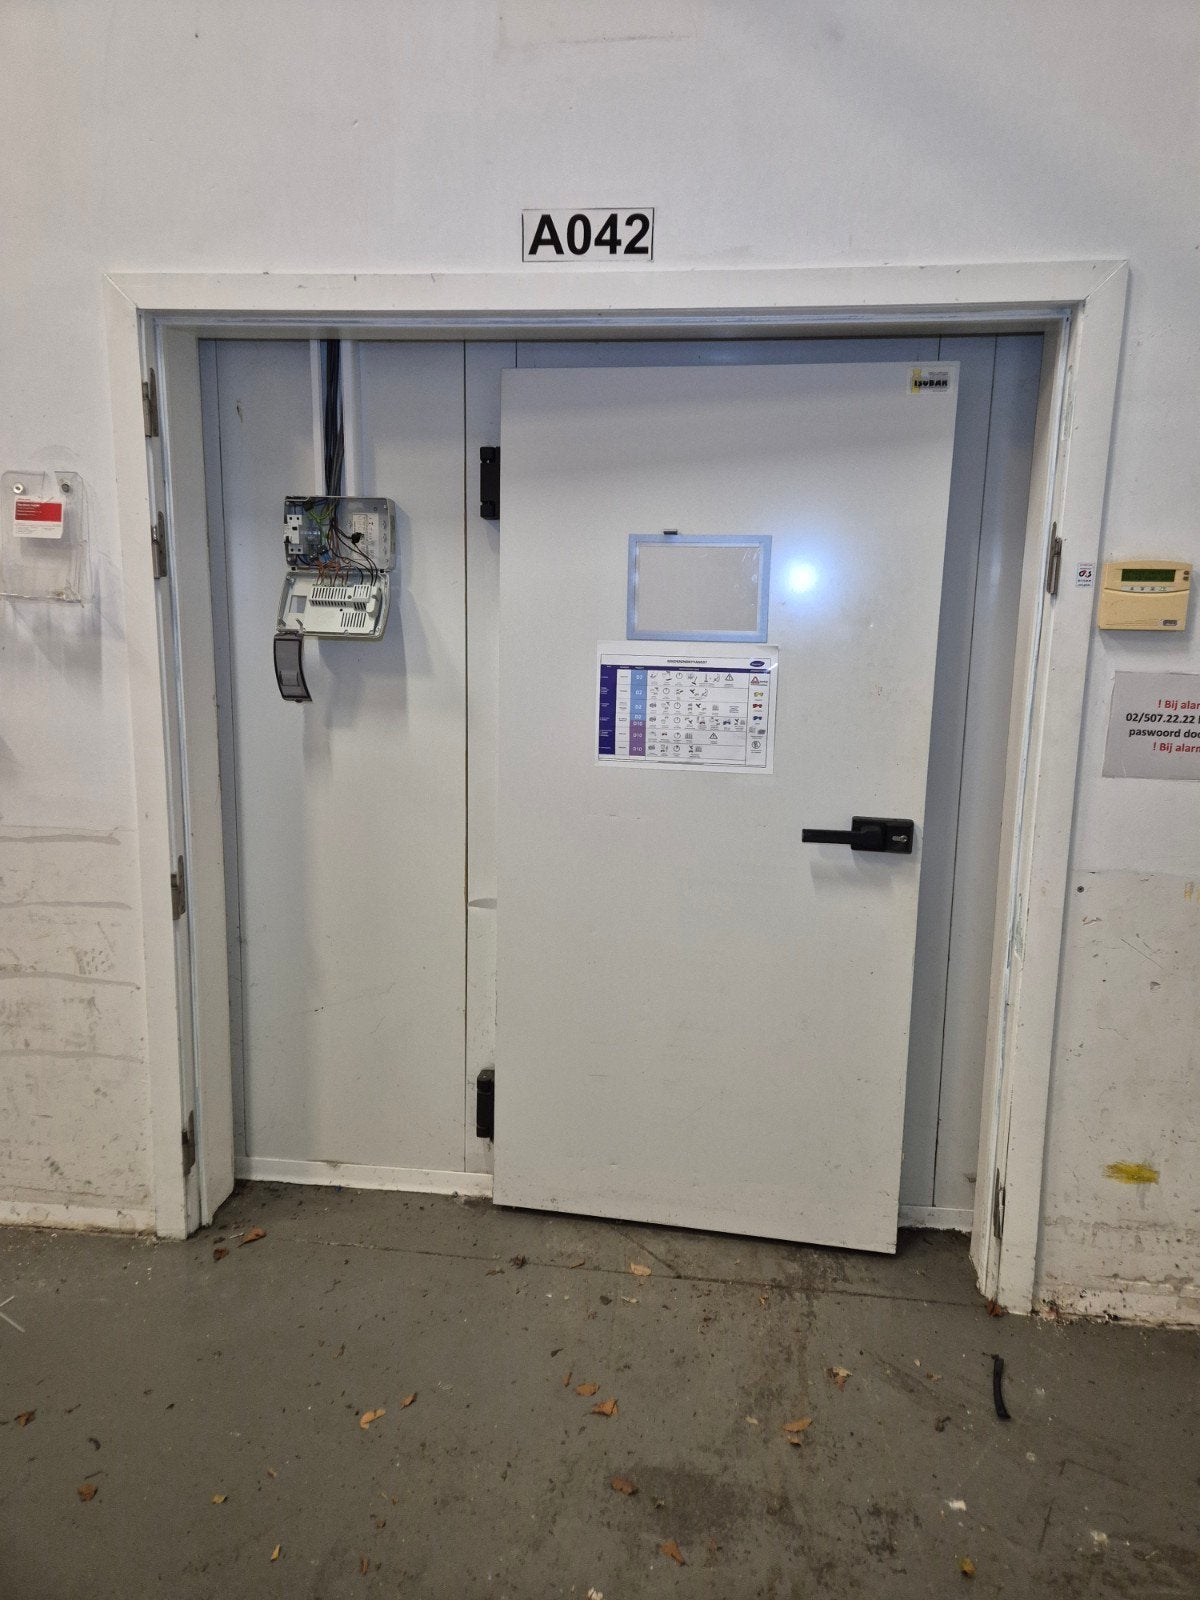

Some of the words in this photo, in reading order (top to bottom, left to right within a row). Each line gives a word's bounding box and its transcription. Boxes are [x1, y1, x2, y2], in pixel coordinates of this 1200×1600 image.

[528, 213, 650, 256] A042
[1164, 700, 1178, 711] Bij
[1125, 712, 1196, 724] 02/507.22.22
[1128, 729, 1181, 738] paswoord
[1159, 742, 1173, 754] Bij
